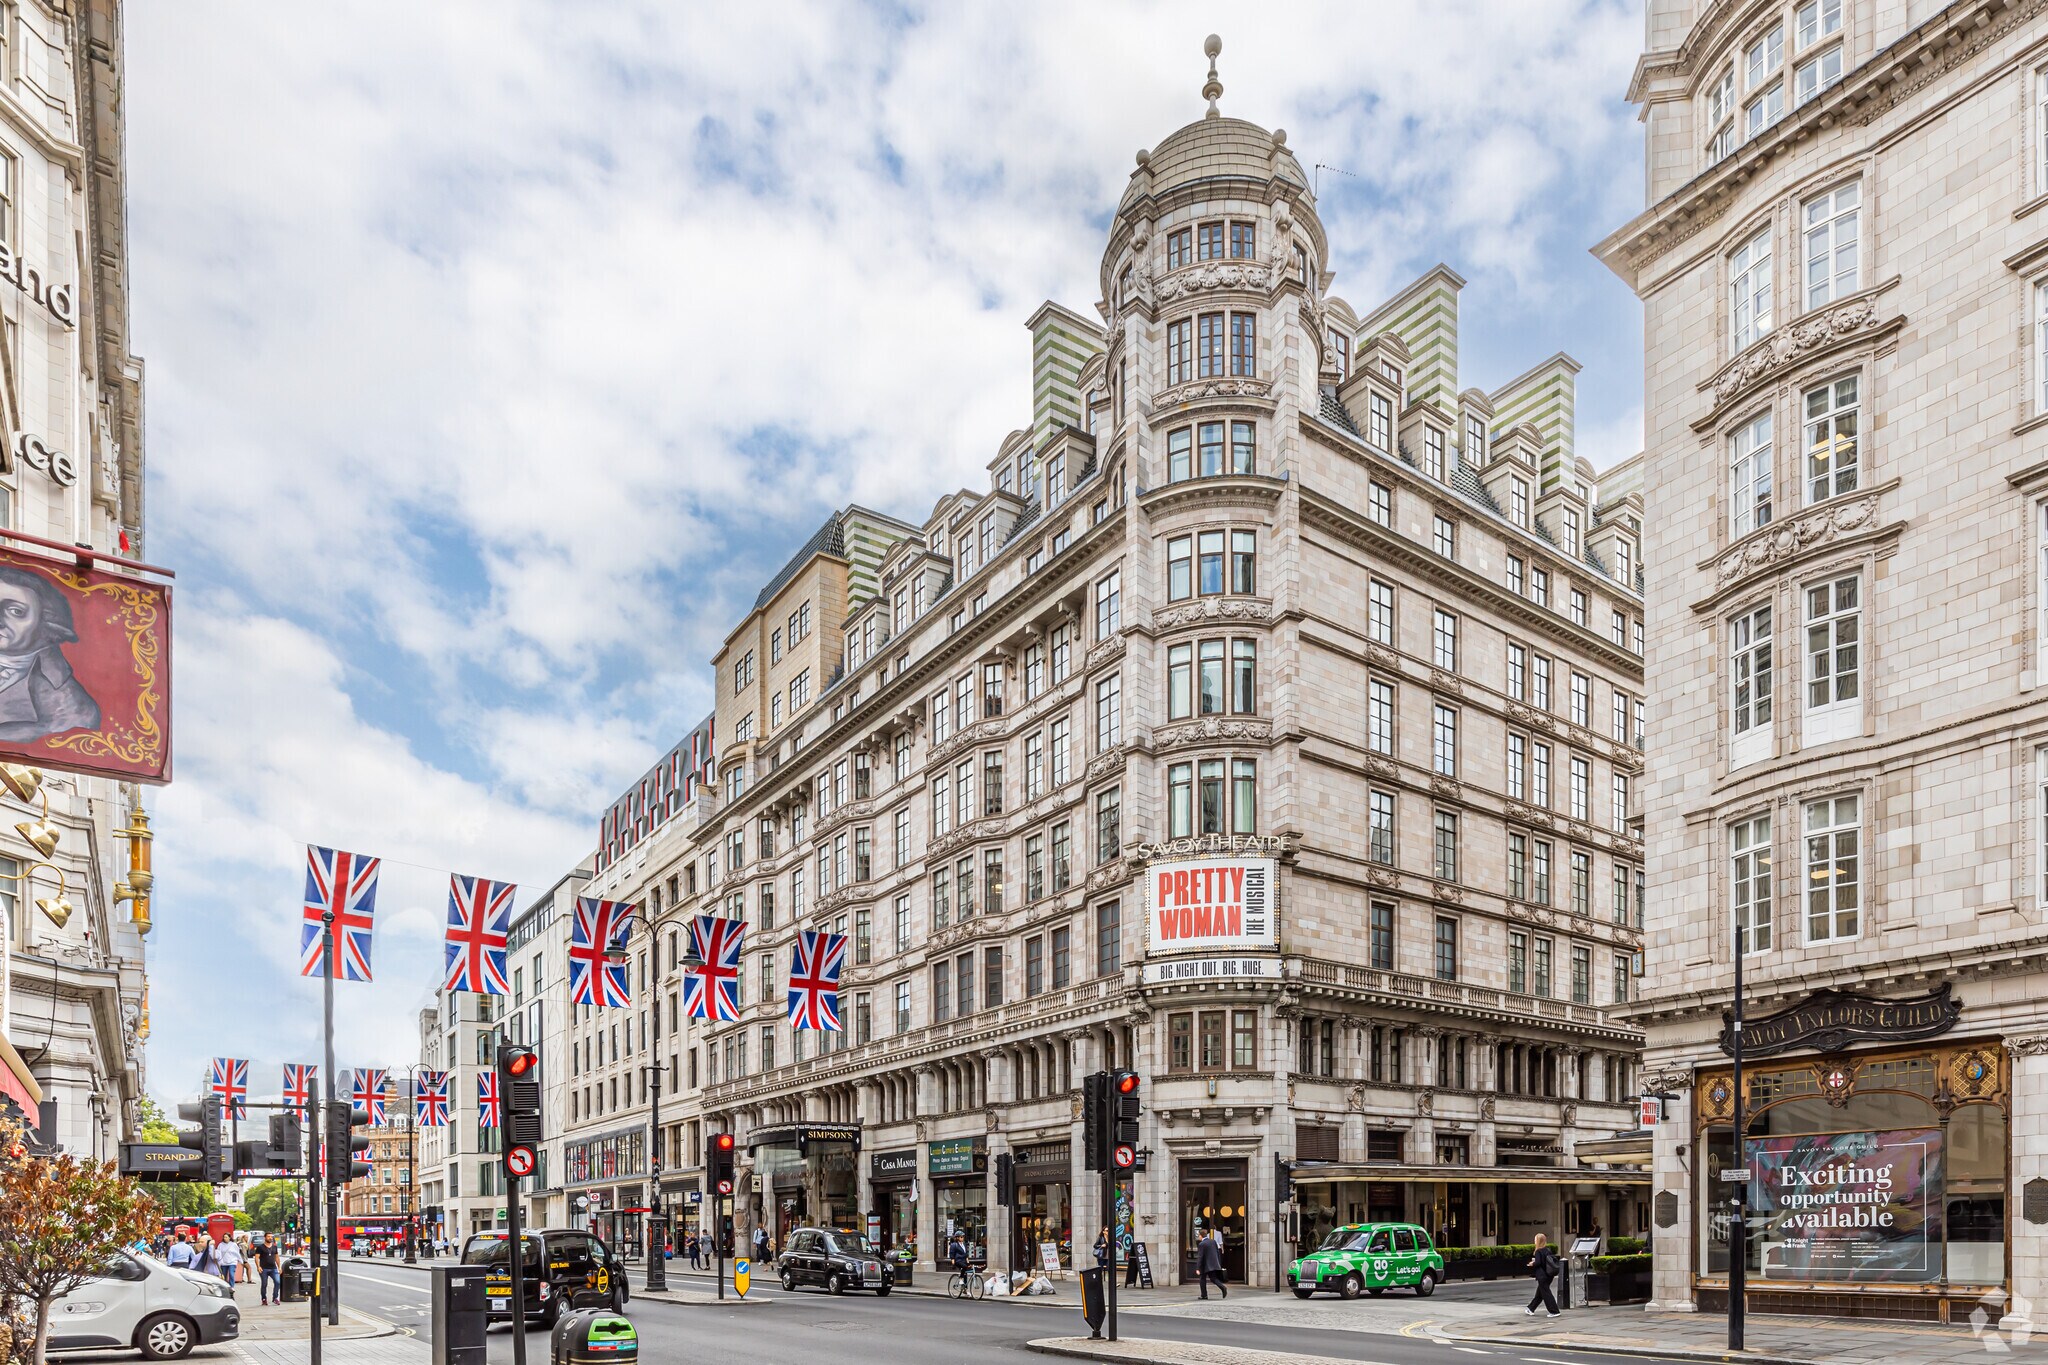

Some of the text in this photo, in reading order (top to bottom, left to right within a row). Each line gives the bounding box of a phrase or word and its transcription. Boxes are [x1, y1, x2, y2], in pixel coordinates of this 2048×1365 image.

[1138, 833, 1292, 859] SAVOY THEATRE
[1159, 867, 1245, 907] PRETTY
[1246, 867, 1265, 936] THE MUSICAL
[1159, 906, 1241, 940] WOMAN
[1160, 960, 1265, 979] BIG NIGHT OUT. BIG. HUGE.
[1740, 1003, 1942, 1047] SAVOY TAYLORS GUILD
[808, 1131, 853, 1139] SIMPSON'S
[145, 1153, 185, 1161] STRAND
[896, 1157, 917, 1169] MANOL
[1780, 1162, 1893, 1189] Exciting
[1780, 1188, 1893, 1210] opportunity
[1780, 1206, 1893, 1229] available
[1396, 1265, 1421, 1275] Let's go!
